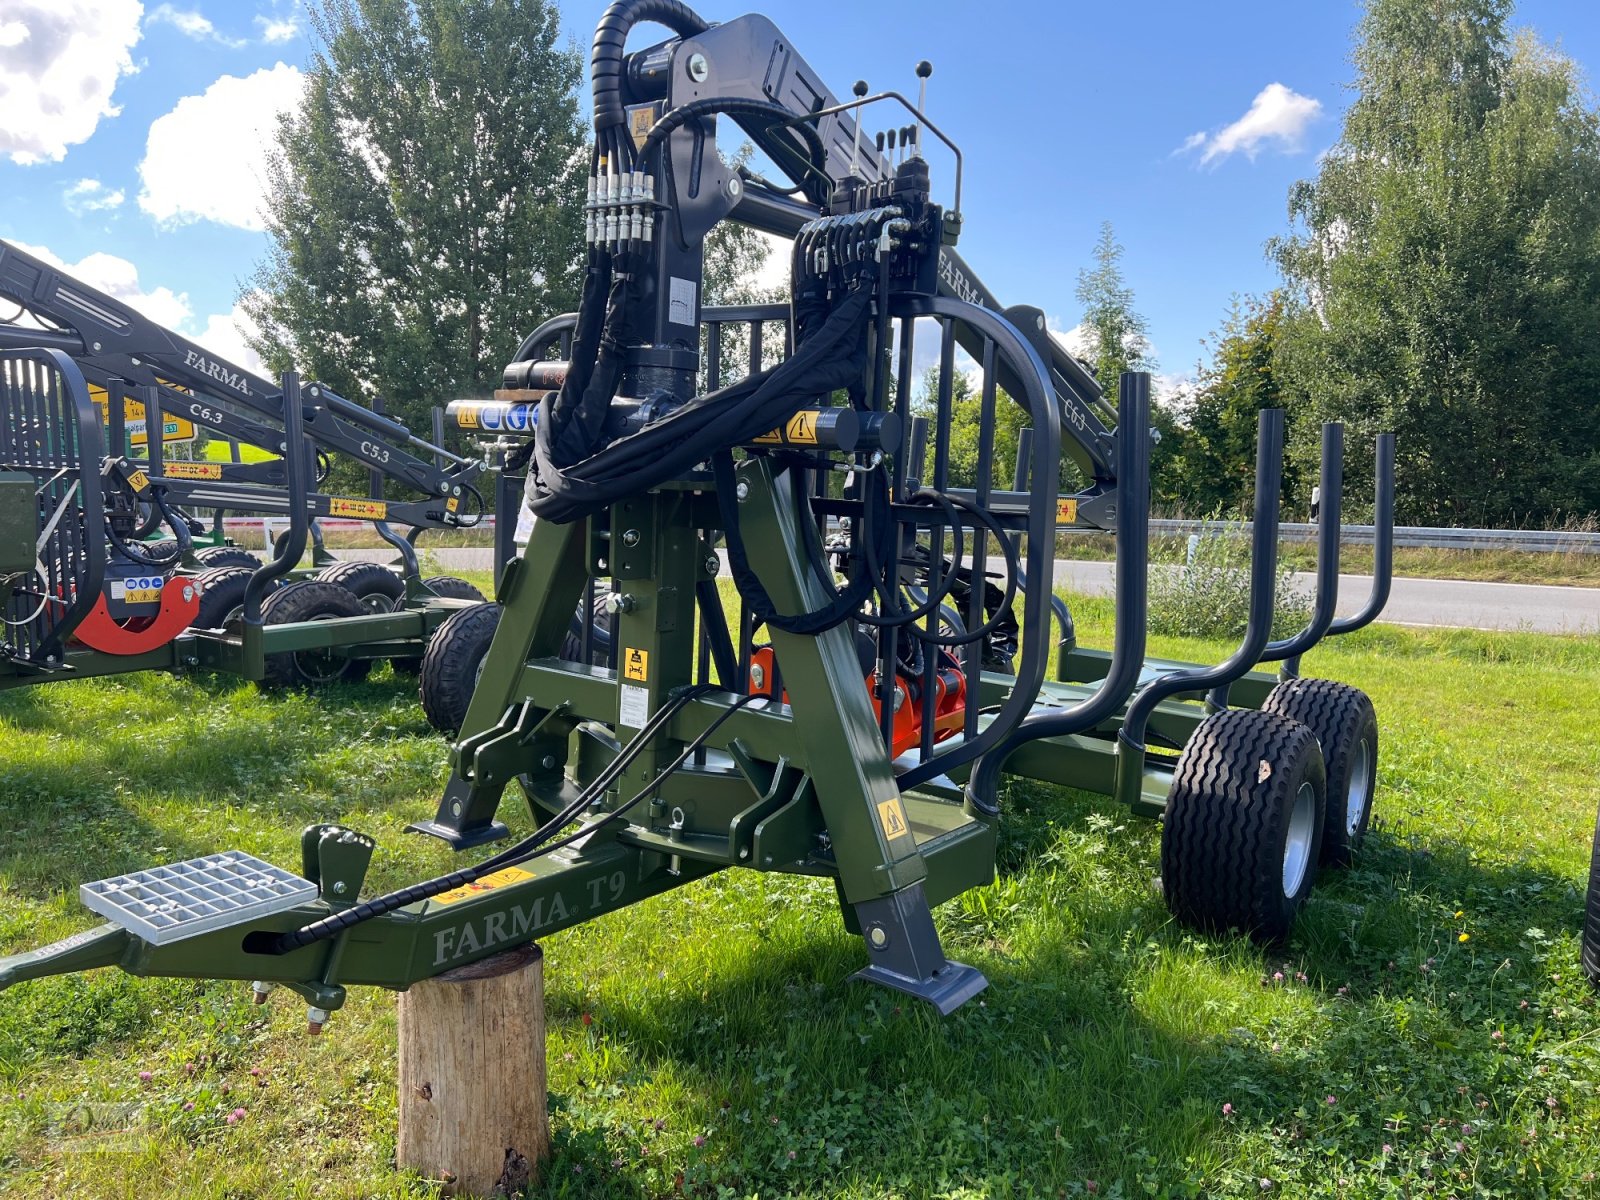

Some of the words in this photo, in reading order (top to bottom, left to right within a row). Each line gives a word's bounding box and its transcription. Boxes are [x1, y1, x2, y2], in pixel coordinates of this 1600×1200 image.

[189, 403, 223, 424] C6.3
[1064, 398, 1086, 431] C6.3
[360, 441, 390, 463] C5.3
[586, 870, 626, 909] T9
